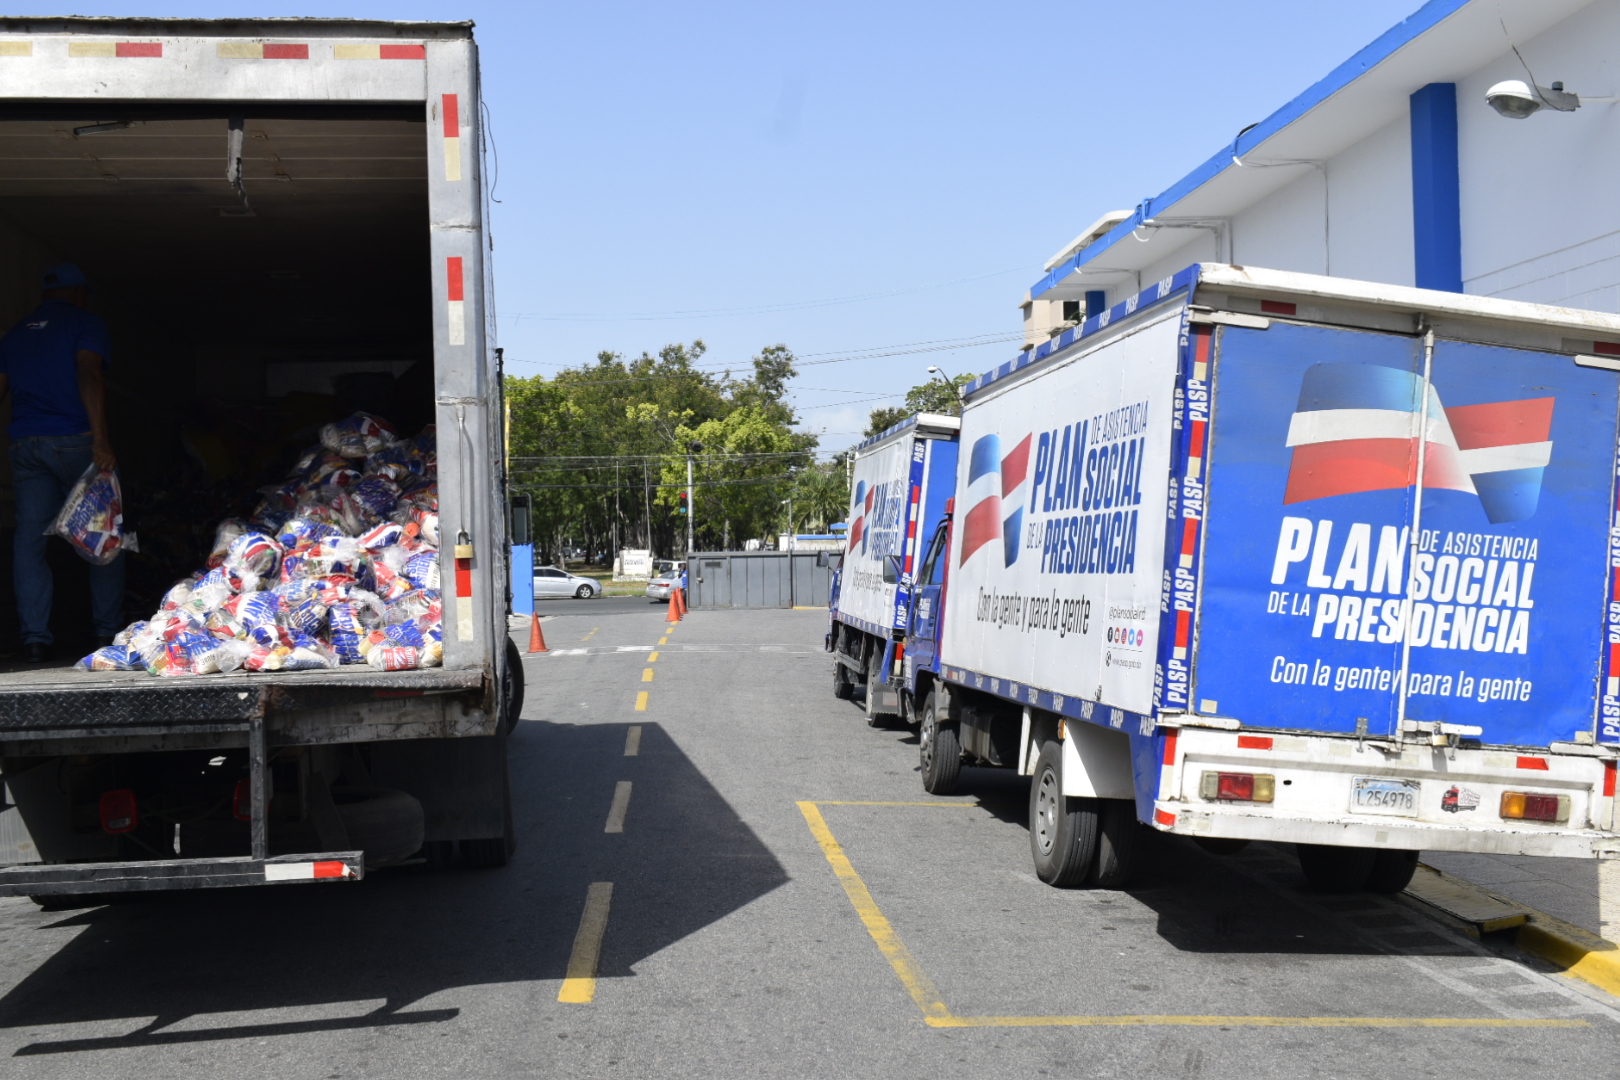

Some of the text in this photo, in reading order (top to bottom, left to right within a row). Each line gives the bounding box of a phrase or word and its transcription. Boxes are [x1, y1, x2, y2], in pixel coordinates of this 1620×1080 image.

[1125, 293, 1139, 316] PASP
[1157, 275, 1173, 299] PASP
[1180, 305, 1190, 346] PASP
[1174, 388, 1185, 430] PASP
[1187, 378, 1208, 422] PASP
[1091, 401, 1148, 445] DE ASISTENCIA
[913, 441, 925, 463] PASP
[1030, 419, 1145, 514] PLAN SOCIAL
[1168, 477, 1178, 519] PASP
[1183, 476, 1203, 520] PASP
[1041, 509, 1138, 574] PRESIDENCIA
[1270, 516, 1539, 595] PLAN DE ASISTENCIA
[1161, 570, 1172, 613] PASP
[1174, 568, 1195, 612] PASP
[1406, 553, 1535, 609] SOCIAL
[896, 605, 907, 626] PASP
[977, 586, 991, 622] Con
[998, 591, 1021, 630] gente
[1021, 597, 1028, 632] y
[1027, 597, 1049, 633] para
[1049, 588, 1060, 631] la
[1060, 594, 1091, 638] gente
[1267, 591, 1530, 654] DE LA PRESIDENCIA
[1152, 664, 1164, 708] PASP
[1167, 659, 1188, 704] PASP
[1270, 655, 1532, 702] Con la gente y para la gente
[1110, 708, 1124, 729] PASP
[1139, 716, 1156, 737] PASP
[1603, 694, 1620, 737] PASP
[1357, 789, 1413, 809] L254978
